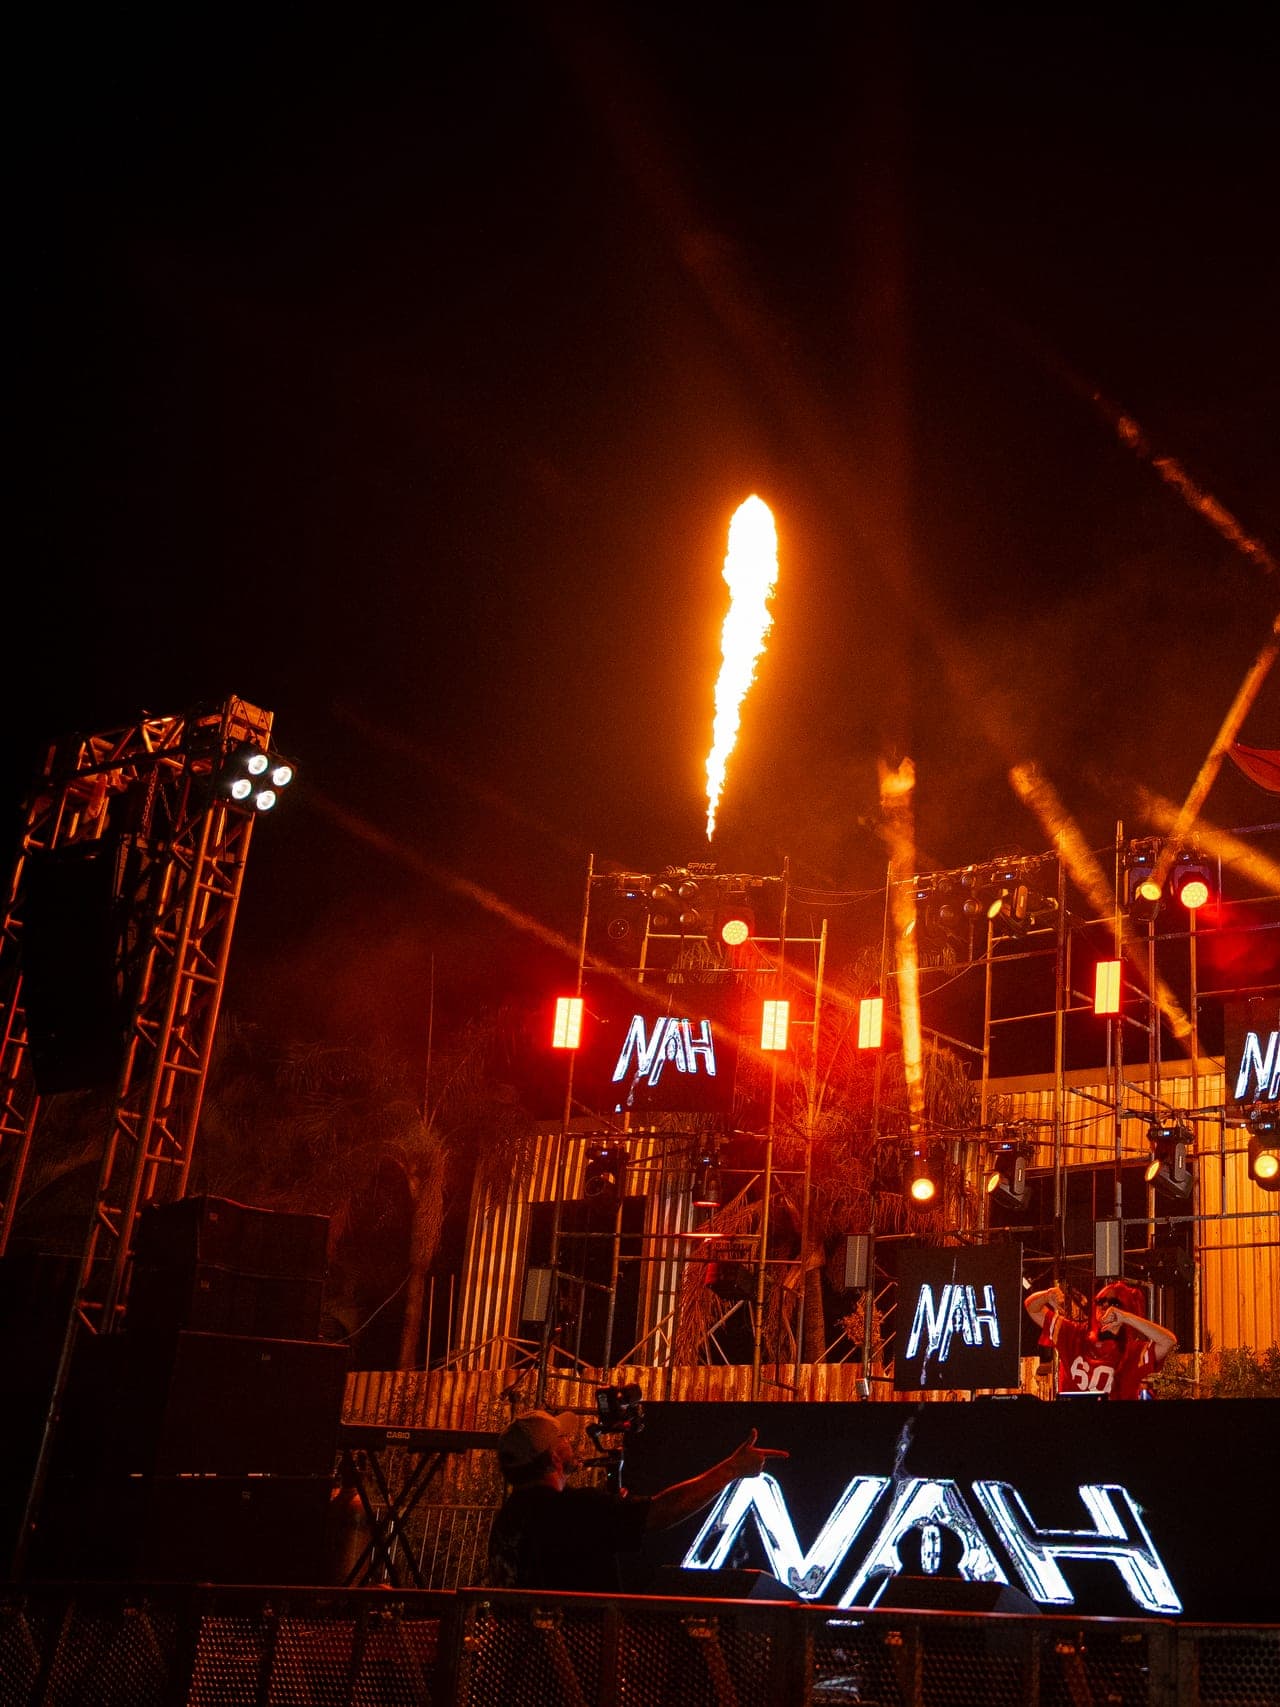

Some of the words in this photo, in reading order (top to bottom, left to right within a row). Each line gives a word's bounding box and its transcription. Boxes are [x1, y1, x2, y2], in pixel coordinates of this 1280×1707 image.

[687, 862, 717, 870] SPACE
[611, 1014, 717, 1086] NAH
[905, 1283, 1001, 1363] NAH
[1070, 1355, 1115, 1393] 60
[680, 1471, 1185, 1614] NAH
